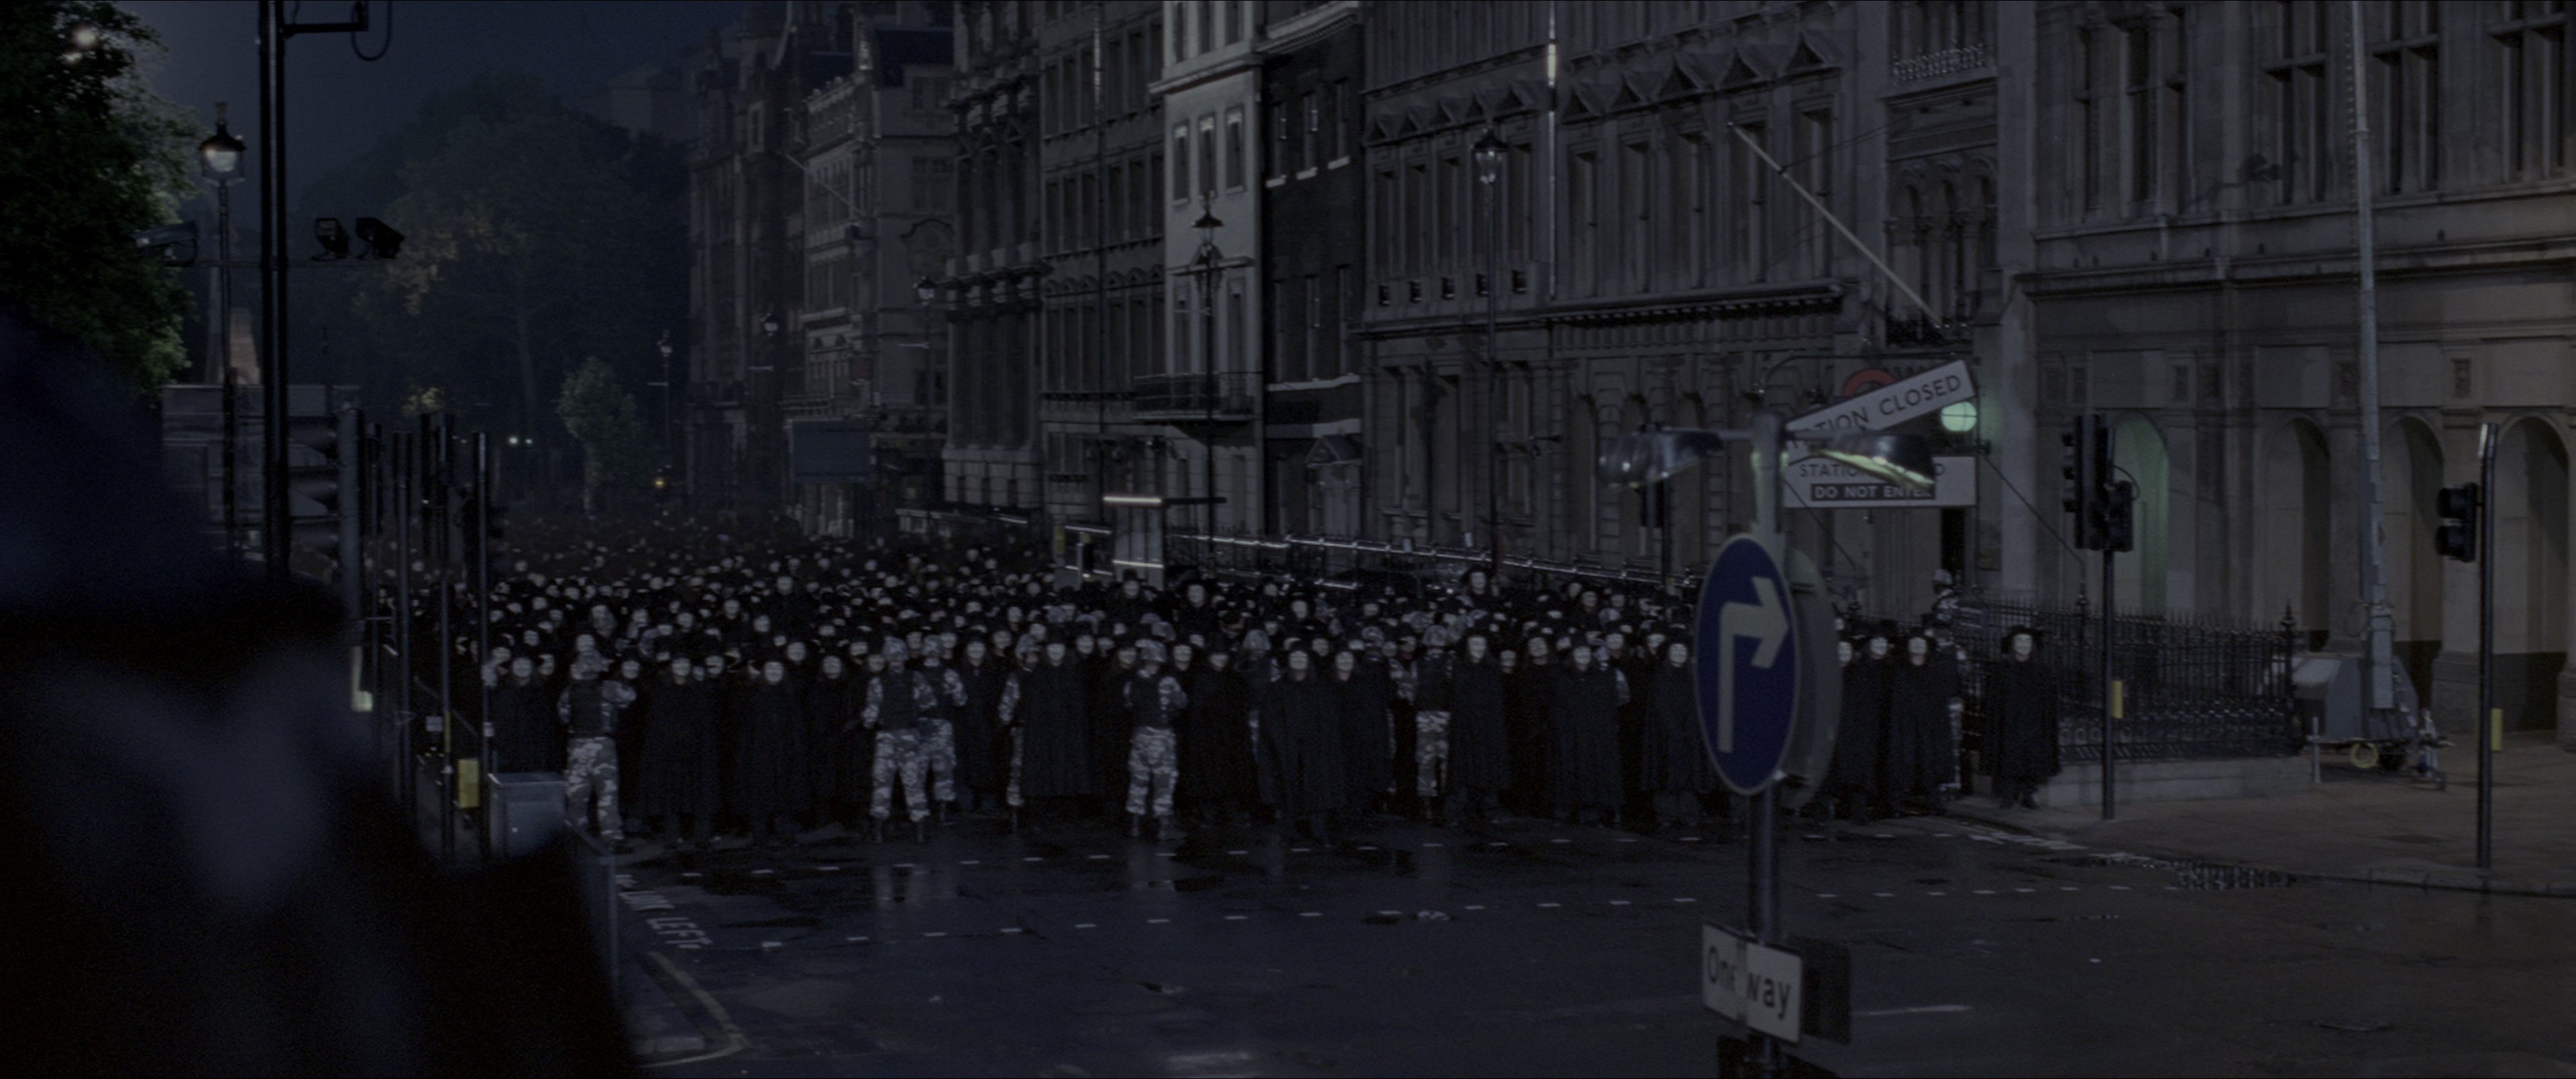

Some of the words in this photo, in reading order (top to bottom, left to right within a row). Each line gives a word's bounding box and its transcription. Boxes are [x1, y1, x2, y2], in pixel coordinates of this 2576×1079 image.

[1879, 374, 1961, 415] CLOSED
[1800, 463, 1860, 477] STATIO
[1814, 485, 1839, 499] DO
[1844, 485, 1878, 498] NOT
[645, 916, 714, 945] LEFT
